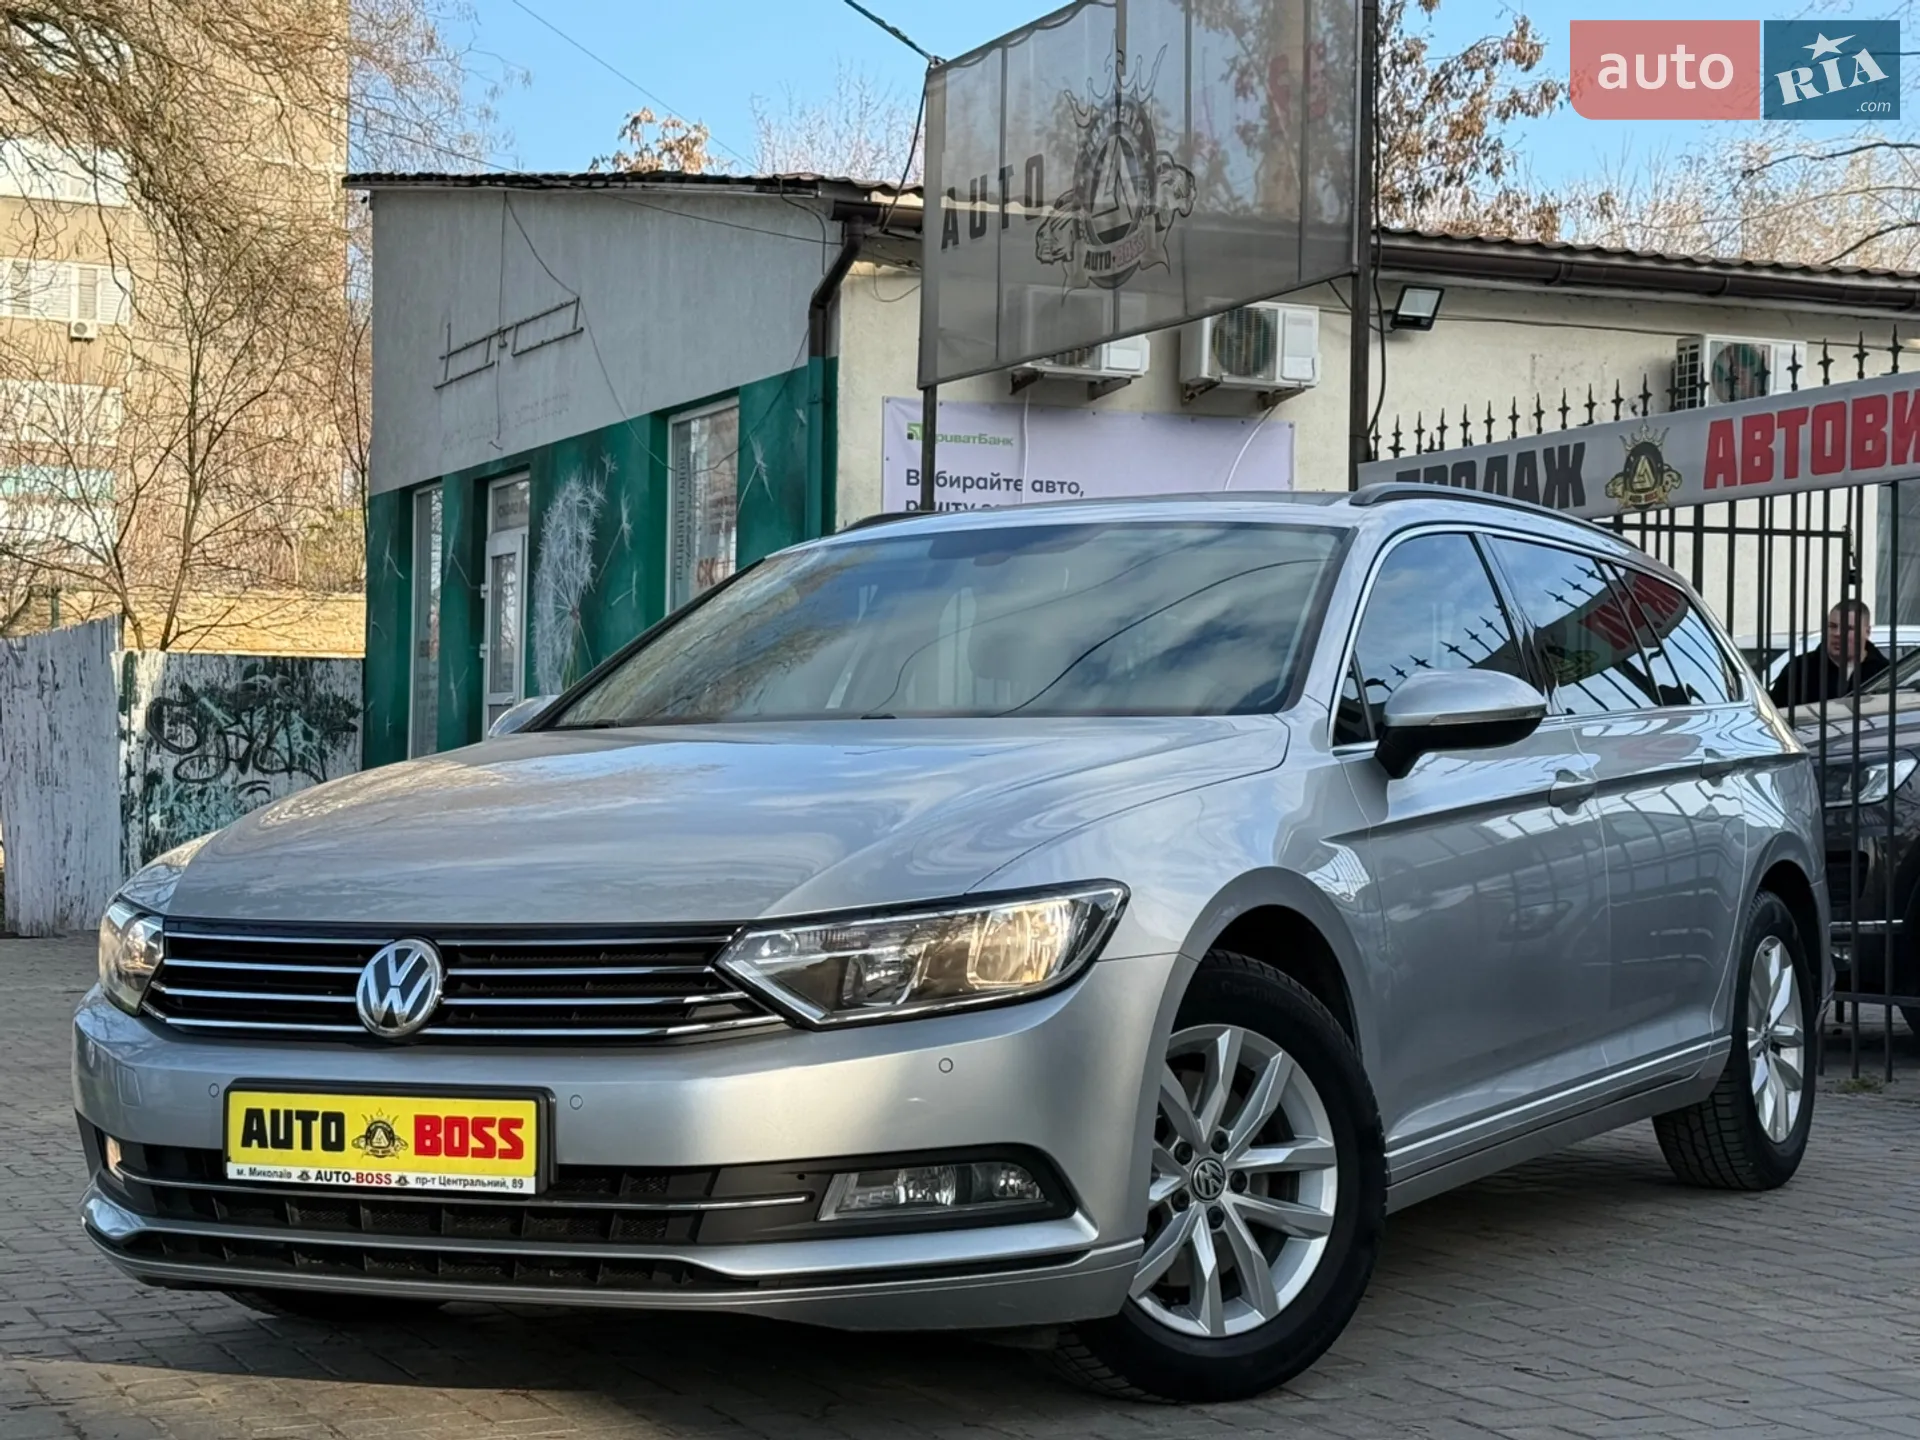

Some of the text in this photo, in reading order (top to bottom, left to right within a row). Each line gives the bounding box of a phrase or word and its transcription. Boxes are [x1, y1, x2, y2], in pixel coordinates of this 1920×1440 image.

[941, 152, 1045, 251] AUTO
[935, 432, 1015, 446] риватБанк
[905, 468, 1085, 497] Вбирайте авто,
[240, 1108, 524, 1160] AUTO BOSS
[315, 1170, 392, 1185] AUTO-BOSS
[415, 1176, 436, 1187] пр-т
[511, 1178, 524, 1190] 89
